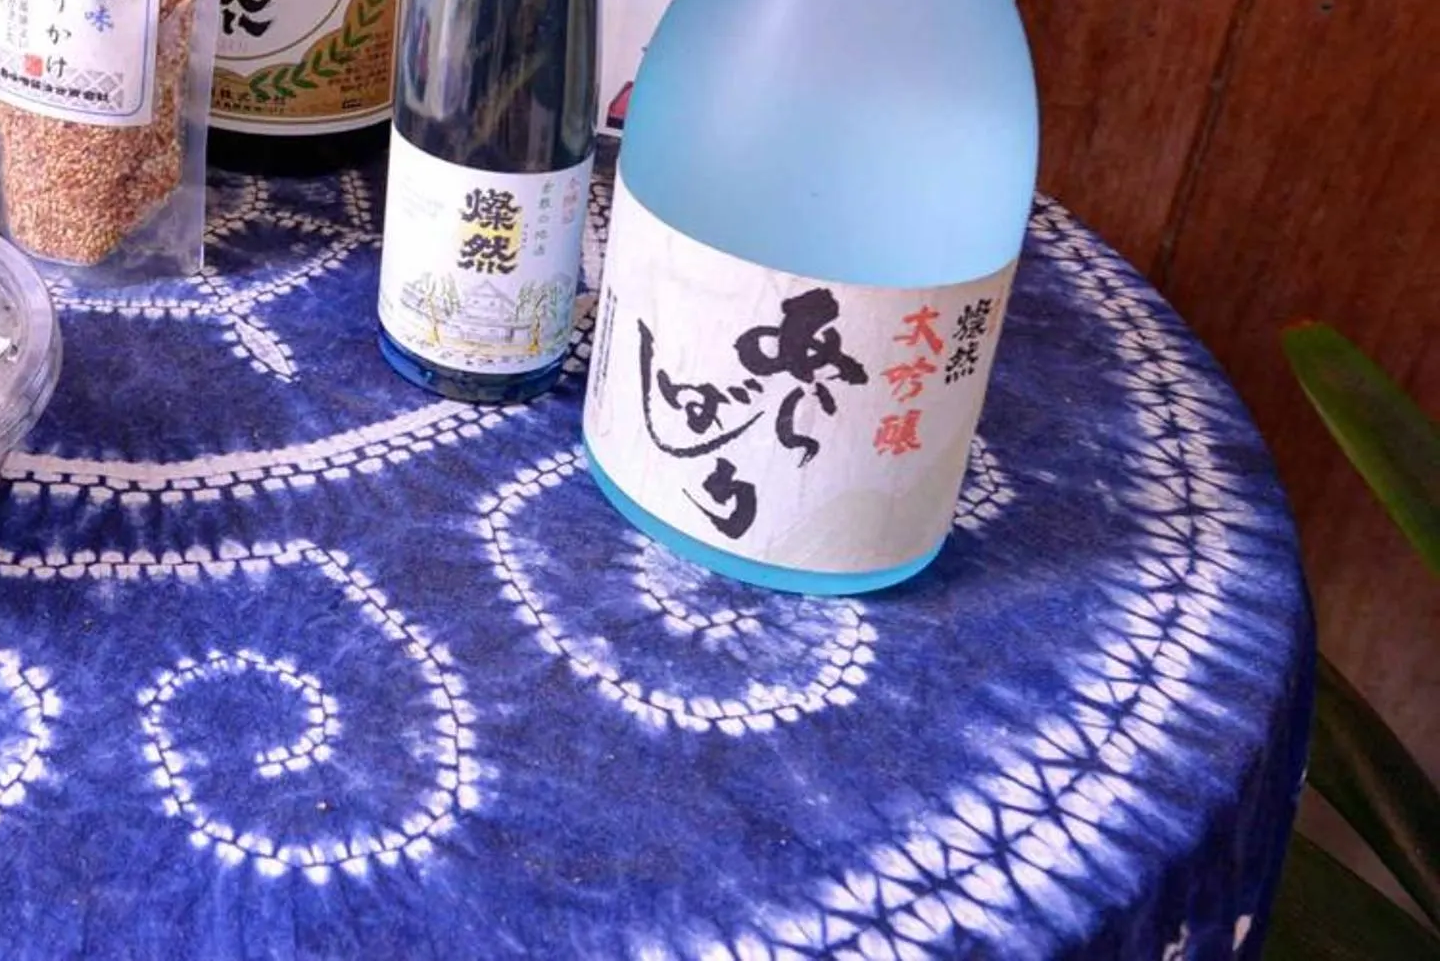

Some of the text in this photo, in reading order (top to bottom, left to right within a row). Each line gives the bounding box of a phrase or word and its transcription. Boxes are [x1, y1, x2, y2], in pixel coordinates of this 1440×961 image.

[456, 186, 524, 276] 燦然
[873, 305, 946, 457] 大吟醸
[945, 298, 993, 386] 燦然
